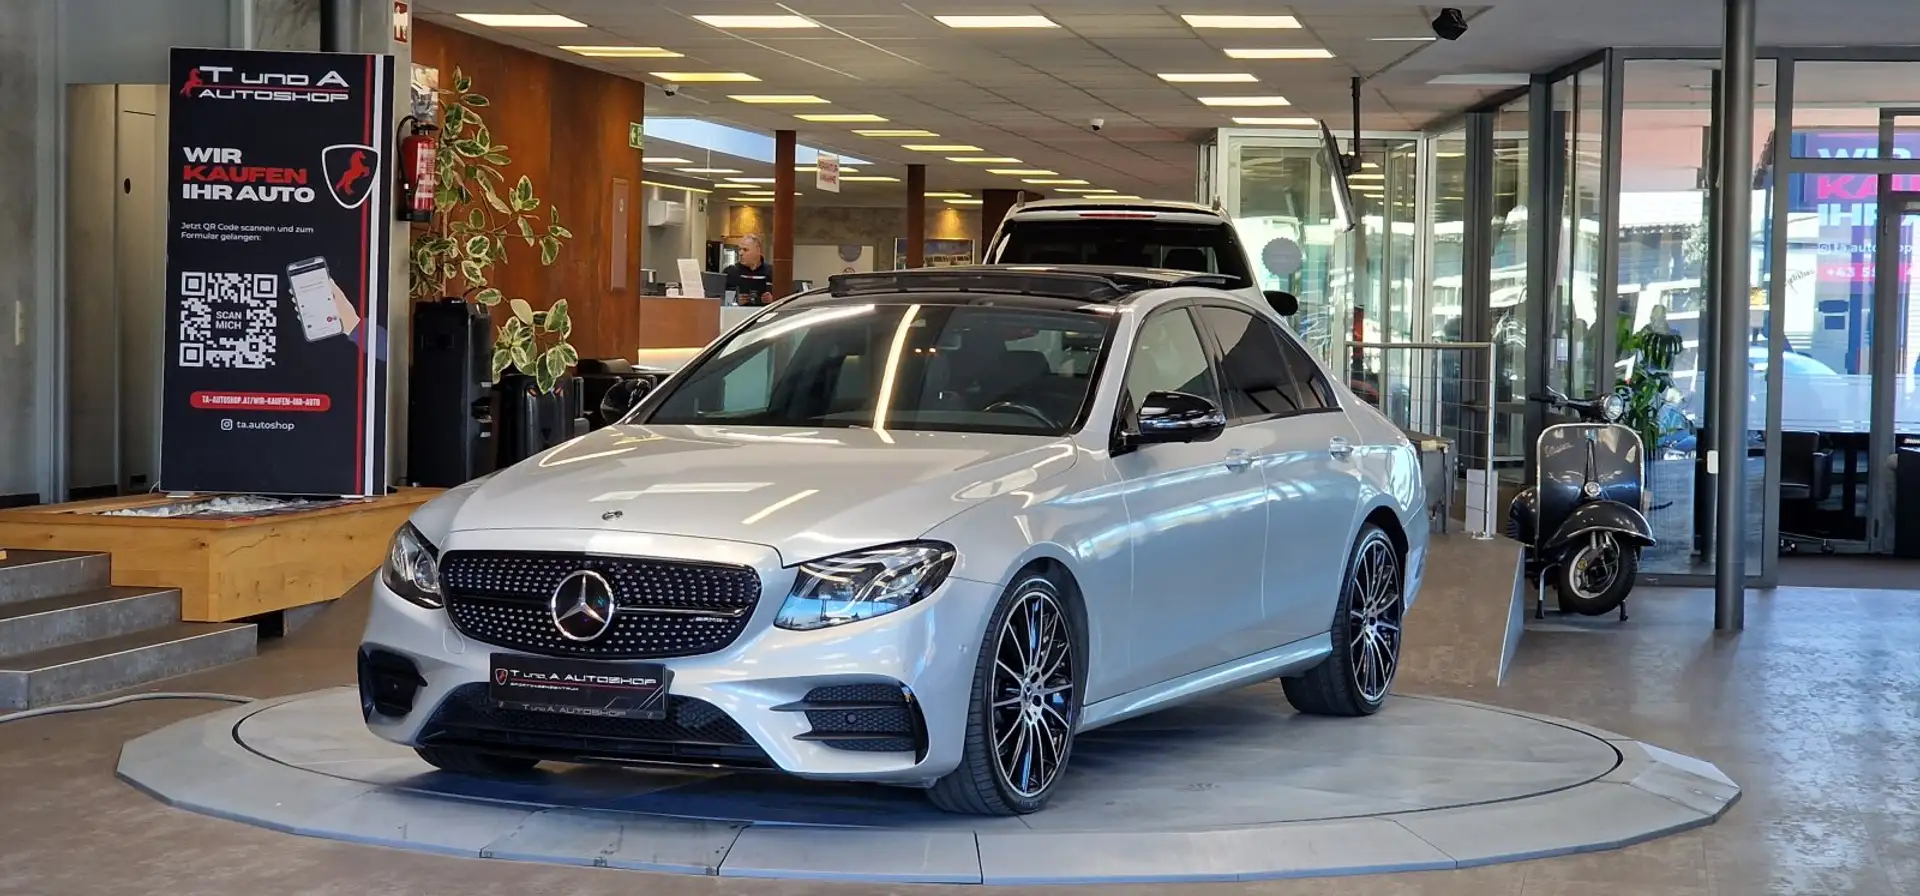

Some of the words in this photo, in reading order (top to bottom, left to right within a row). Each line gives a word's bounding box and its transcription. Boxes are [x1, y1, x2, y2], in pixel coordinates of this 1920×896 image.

[199, 66, 233, 83] T
[316, 70, 349, 88] A
[198, 88, 349, 103] AUTOSHOP
[183, 146, 242, 164] WIR
[183, 165, 307, 184] KAUFEN
[182, 183, 234, 201] IHR
[235, 185, 315, 204] AUTO
[181, 221, 201, 231] Jetzt
[202, 222, 216, 232] QR
[217, 222, 239, 232] Code
[240, 224, 276, 233] scannen
[277, 224, 294, 234] und
[295, 226, 314, 234] zum
[181, 231, 218, 241] Formular
[220, 232, 262, 242] gelangen:
[215, 310, 242, 320] SCAN
[215, 320, 242, 330] MICH
[236, 420, 295, 431] ta.autoshop
[509, 669, 520, 677] T
[549, 672, 560, 680] A
[564, 673, 657, 686] AUTOSHOP
[559, 707, 627, 717] AUTOSHOP
